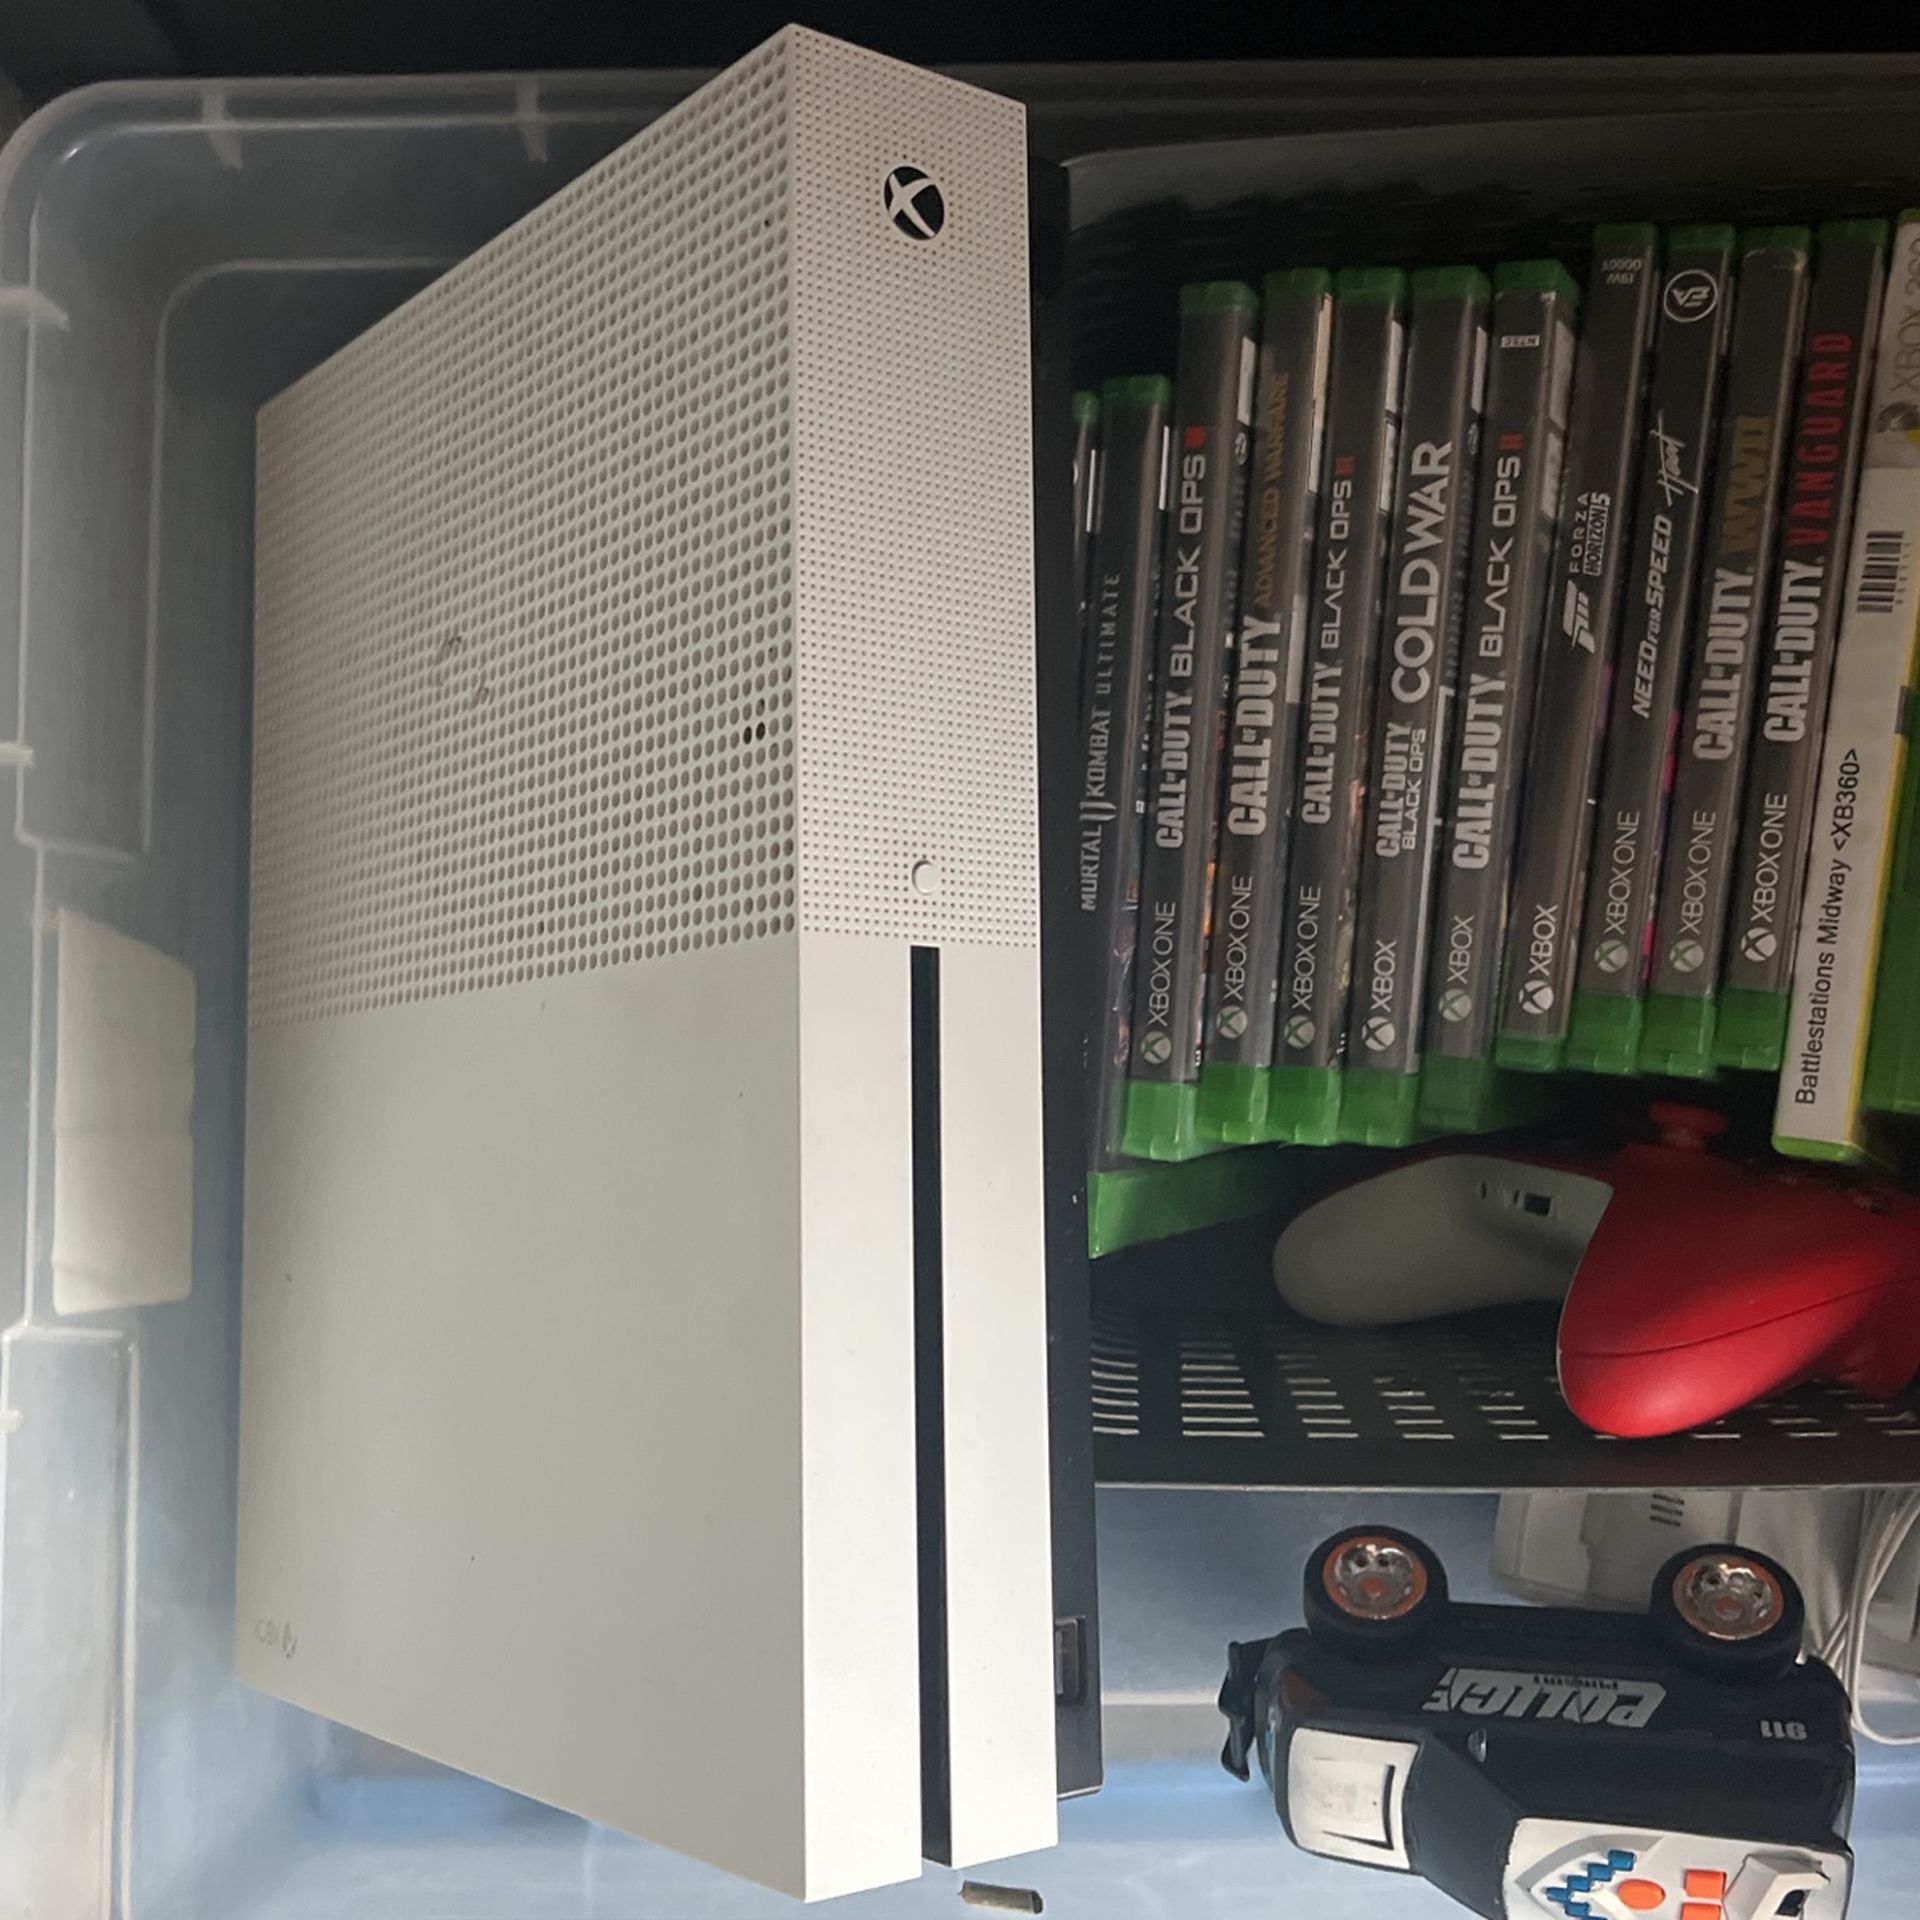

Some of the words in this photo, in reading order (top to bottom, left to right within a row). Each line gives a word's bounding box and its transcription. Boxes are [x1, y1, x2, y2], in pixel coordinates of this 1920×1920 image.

[1263, 371, 1289, 484] WARFARE
[1786, 332, 1852, 547] VANGUARD
[1180, 453, 1206, 535] OPS
[1330, 480, 1352, 540] OPS
[1404, 441, 1452, 554] WAR
[1492, 456, 1520, 527] OPS
[1720, 415, 1776, 555] WWII
[1254, 487, 1281, 608] ADVANCED
[1569, 492, 1589, 574] FORZA
[1095, 573, 1120, 695] ULTIMATE
[1169, 545, 1200, 678] BLACK
[1321, 548, 1347, 649] BLACK
[1391, 558, 1440, 704] COLD
[1479, 537, 1515, 657] BLACK
[1632, 639, 1658, 719] NEED
[1645, 513, 1673, 608] SPEED
[1704, 567, 1754, 664] DUTY
[1775, 560, 1824, 652] DUTY
[1235, 615, 1281, 727] DUTY
[1308, 662, 1342, 744] DUTY
[1764, 659, 1813, 743] CALL
[1086, 705, 1111, 797] KOMBAT
[1161, 691, 1193, 771] DUTY
[1382, 722, 1412, 790] DUTY
[1409, 728, 1426, 773] OPS
[1461, 673, 1506, 772] DUTY
[1693, 674, 1742, 761] CALL
[1156, 778, 1188, 849] CALL
[1227, 738, 1272, 836] CALL
[1302, 753, 1335, 824] CALL
[1376, 797, 1403, 858] CALL
[1402, 777, 1422, 850] BLACK
[1453, 784, 1496, 869] CALL
[1760, 793, 1787, 849] ONE
[1830, 748, 1861, 851] <XB360>
[1613, 810, 1640, 864] ONE
[1688, 810, 1716, 864] ONE
[1229, 875, 1254, 930] ONE
[1297, 886, 1321, 939] ONE
[1604, 867, 1634, 935] XBOX
[1679, 867, 1709, 935] XBOX
[1751, 852, 1781, 923] XBOX
[1816, 858, 1853, 945] Midway
[1152, 902, 1176, 955] ONE
[1224, 932, 1249, 1001] XBOX
[1447, 915, 1474, 984] XBOX
[1528, 904, 1558, 976] XBOX
[1147, 959, 1172, 1027] XBOX
[1292, 942, 1316, 1011] XBOX
[1370, 940, 1397, 1012] XBOX
[1794, 951, 1835, 1105] Battlestations
[1422, 1667, 1667, 1729] POLICE
[1759, 1719, 1808, 1740] 911
